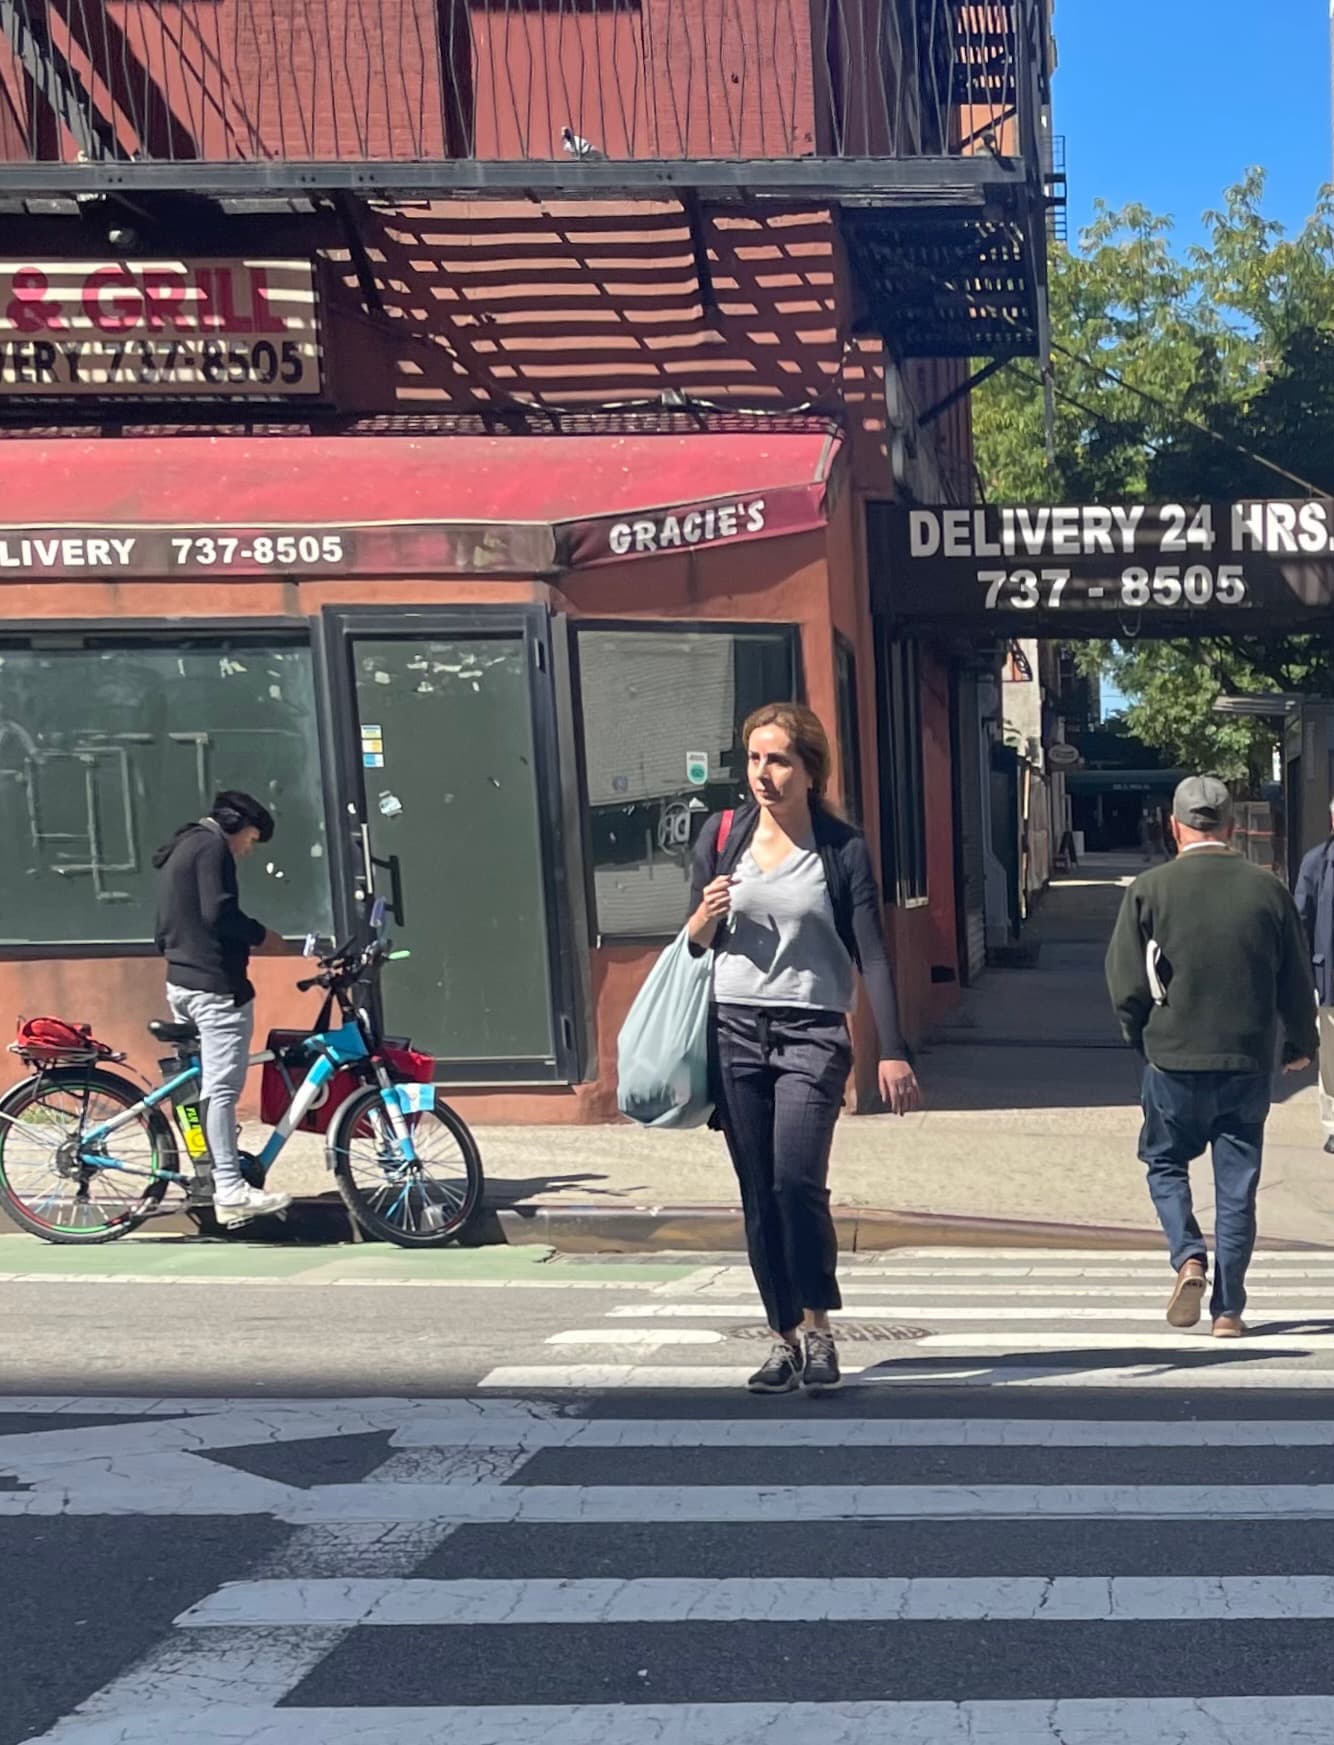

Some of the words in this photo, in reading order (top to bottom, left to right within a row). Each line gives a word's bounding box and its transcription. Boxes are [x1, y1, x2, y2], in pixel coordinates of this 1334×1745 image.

[6, 267, 69, 333] &
[81, 267, 288, 334] GRILL
[99, 340, 303, 384] 737-8505
[0, 538, 136, 566] LIVERY
[171, 536, 343, 564] 737-8505
[609, 499, 765, 554] GRACIE'S
[909, 506, 1145, 557] DELIVERY
[1159, 503, 1215, 552] 24
[977, 569, 1071, 609] 737
[1121, 564, 1245, 606] 8505
